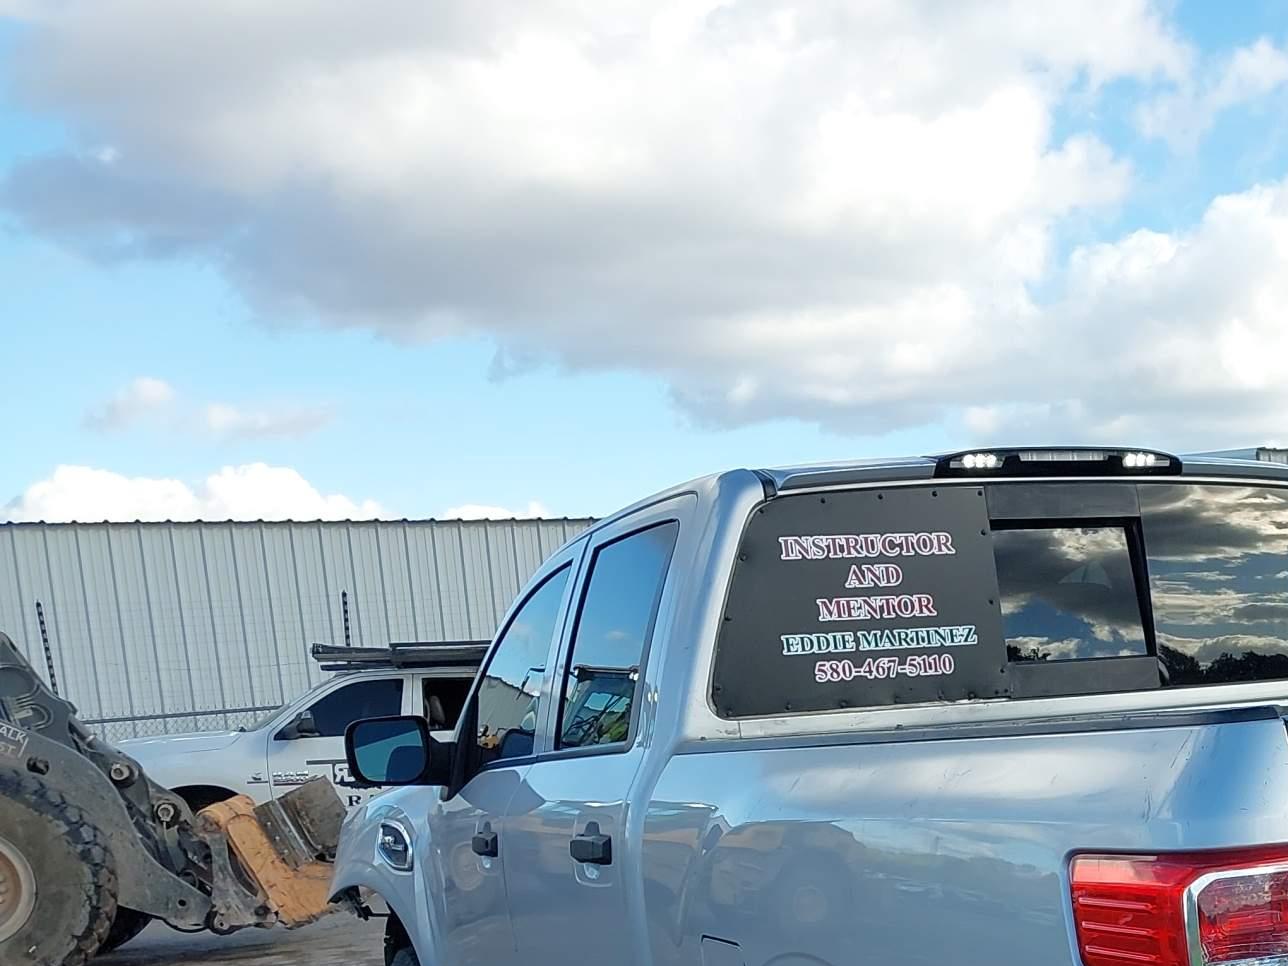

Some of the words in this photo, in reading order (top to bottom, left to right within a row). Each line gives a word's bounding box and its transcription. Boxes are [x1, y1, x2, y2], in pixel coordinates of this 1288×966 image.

[779, 532, 956, 560] INSTRUCTOR
[845, 564, 902, 588] AND
[817, 595, 937, 621] MENTOR
[781, 631, 856, 655] EDDIE
[858, 625, 978, 652] MARTINEZ
[814, 654, 955, 683] 580-467-5110
